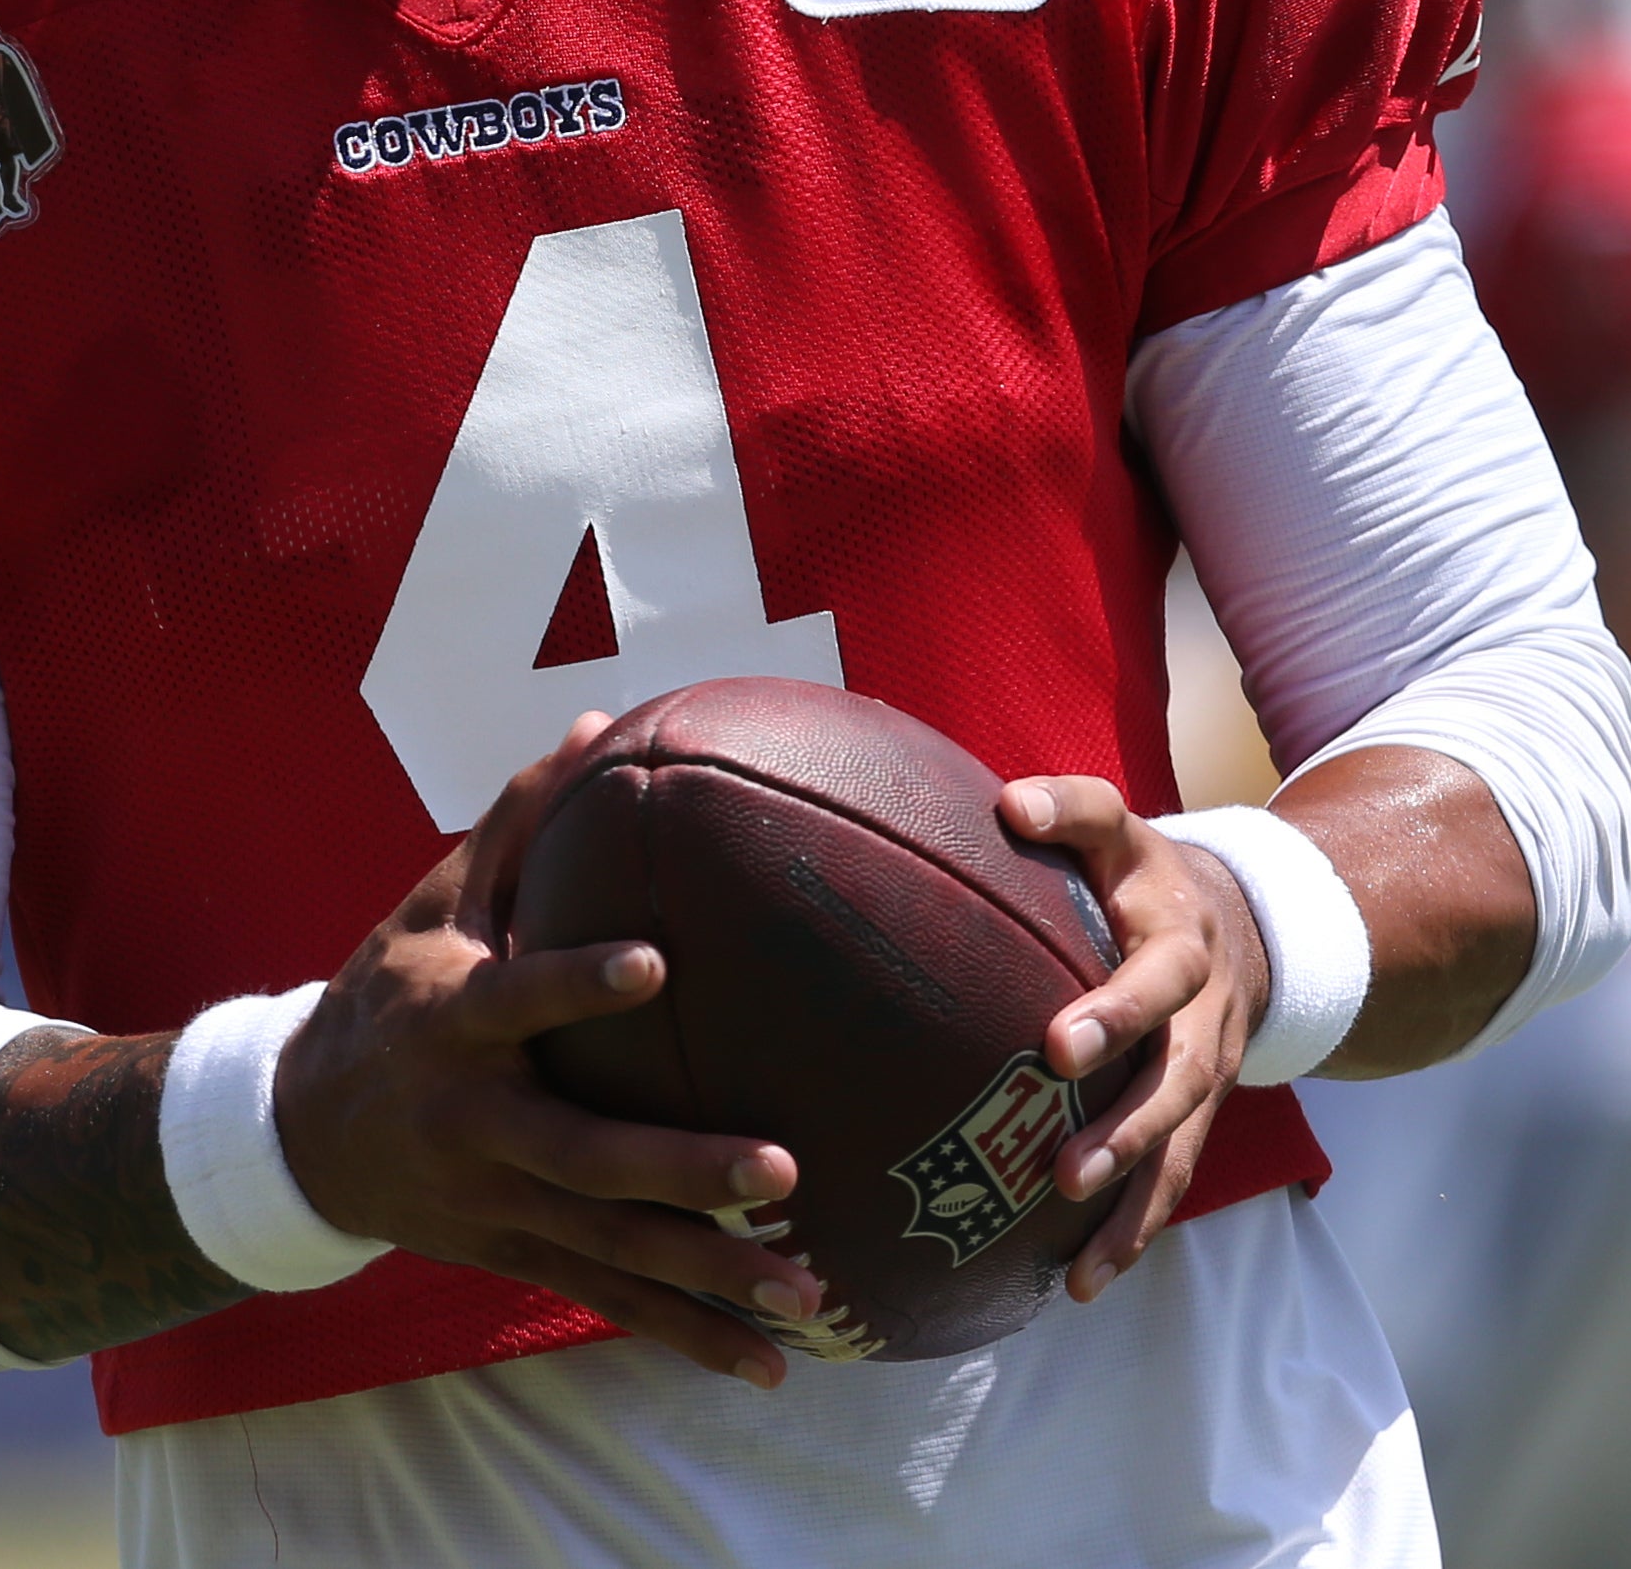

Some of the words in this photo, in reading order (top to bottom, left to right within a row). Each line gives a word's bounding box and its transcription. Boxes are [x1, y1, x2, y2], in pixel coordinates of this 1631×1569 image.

[334, 79, 627, 173] COWBOYS
[359, 208, 845, 834] 4
[973, 1071, 1066, 1206] NFL
